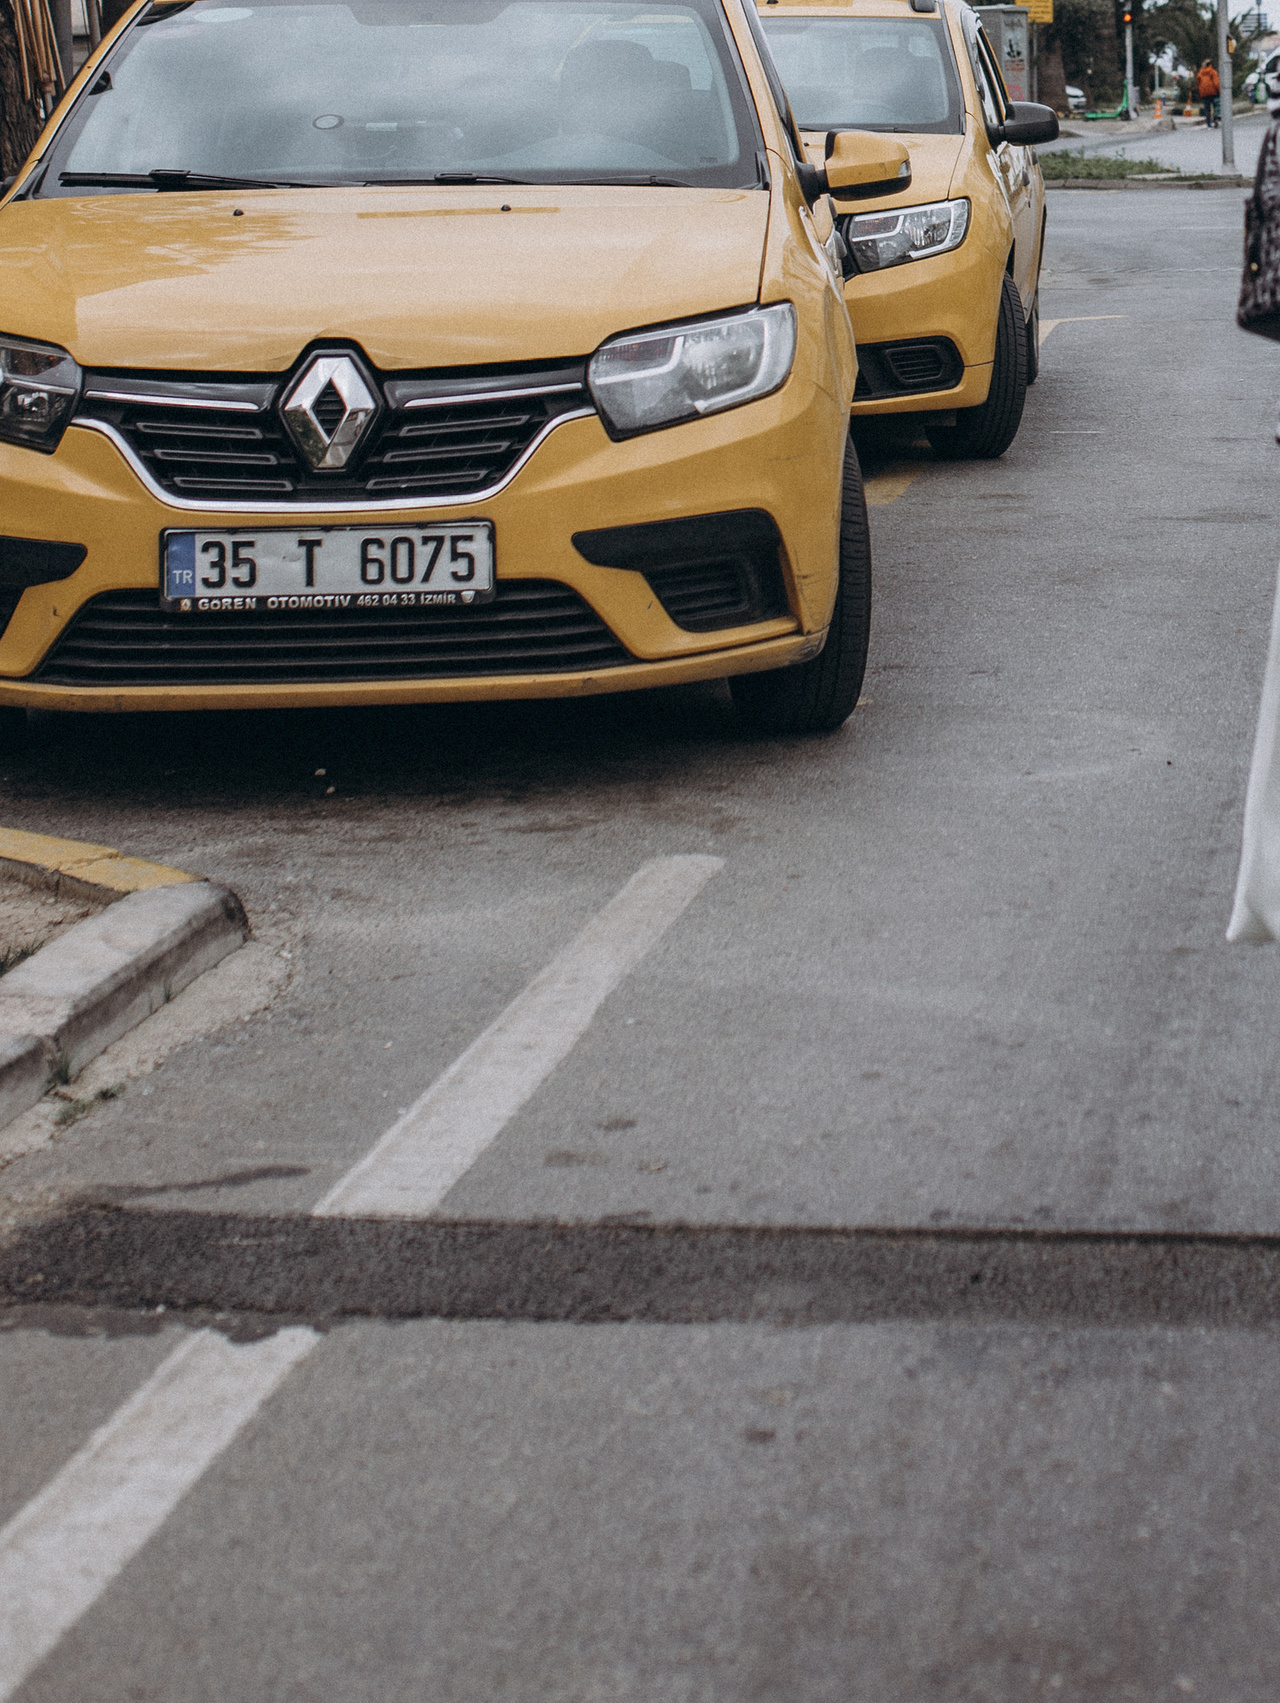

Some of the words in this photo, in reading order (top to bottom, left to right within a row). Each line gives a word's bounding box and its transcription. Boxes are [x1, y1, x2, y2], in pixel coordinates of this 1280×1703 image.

[172, 570, 193, 585] TR
[201, 539, 256, 589] 35
[297, 539, 322, 588] T
[359, 534, 475, 586] 6075
[198, 597, 257, 611] GÖREN
[356, 595, 380, 607] 462
[382, 594, 398, 606] 04
[400, 593, 416, 605] 33
